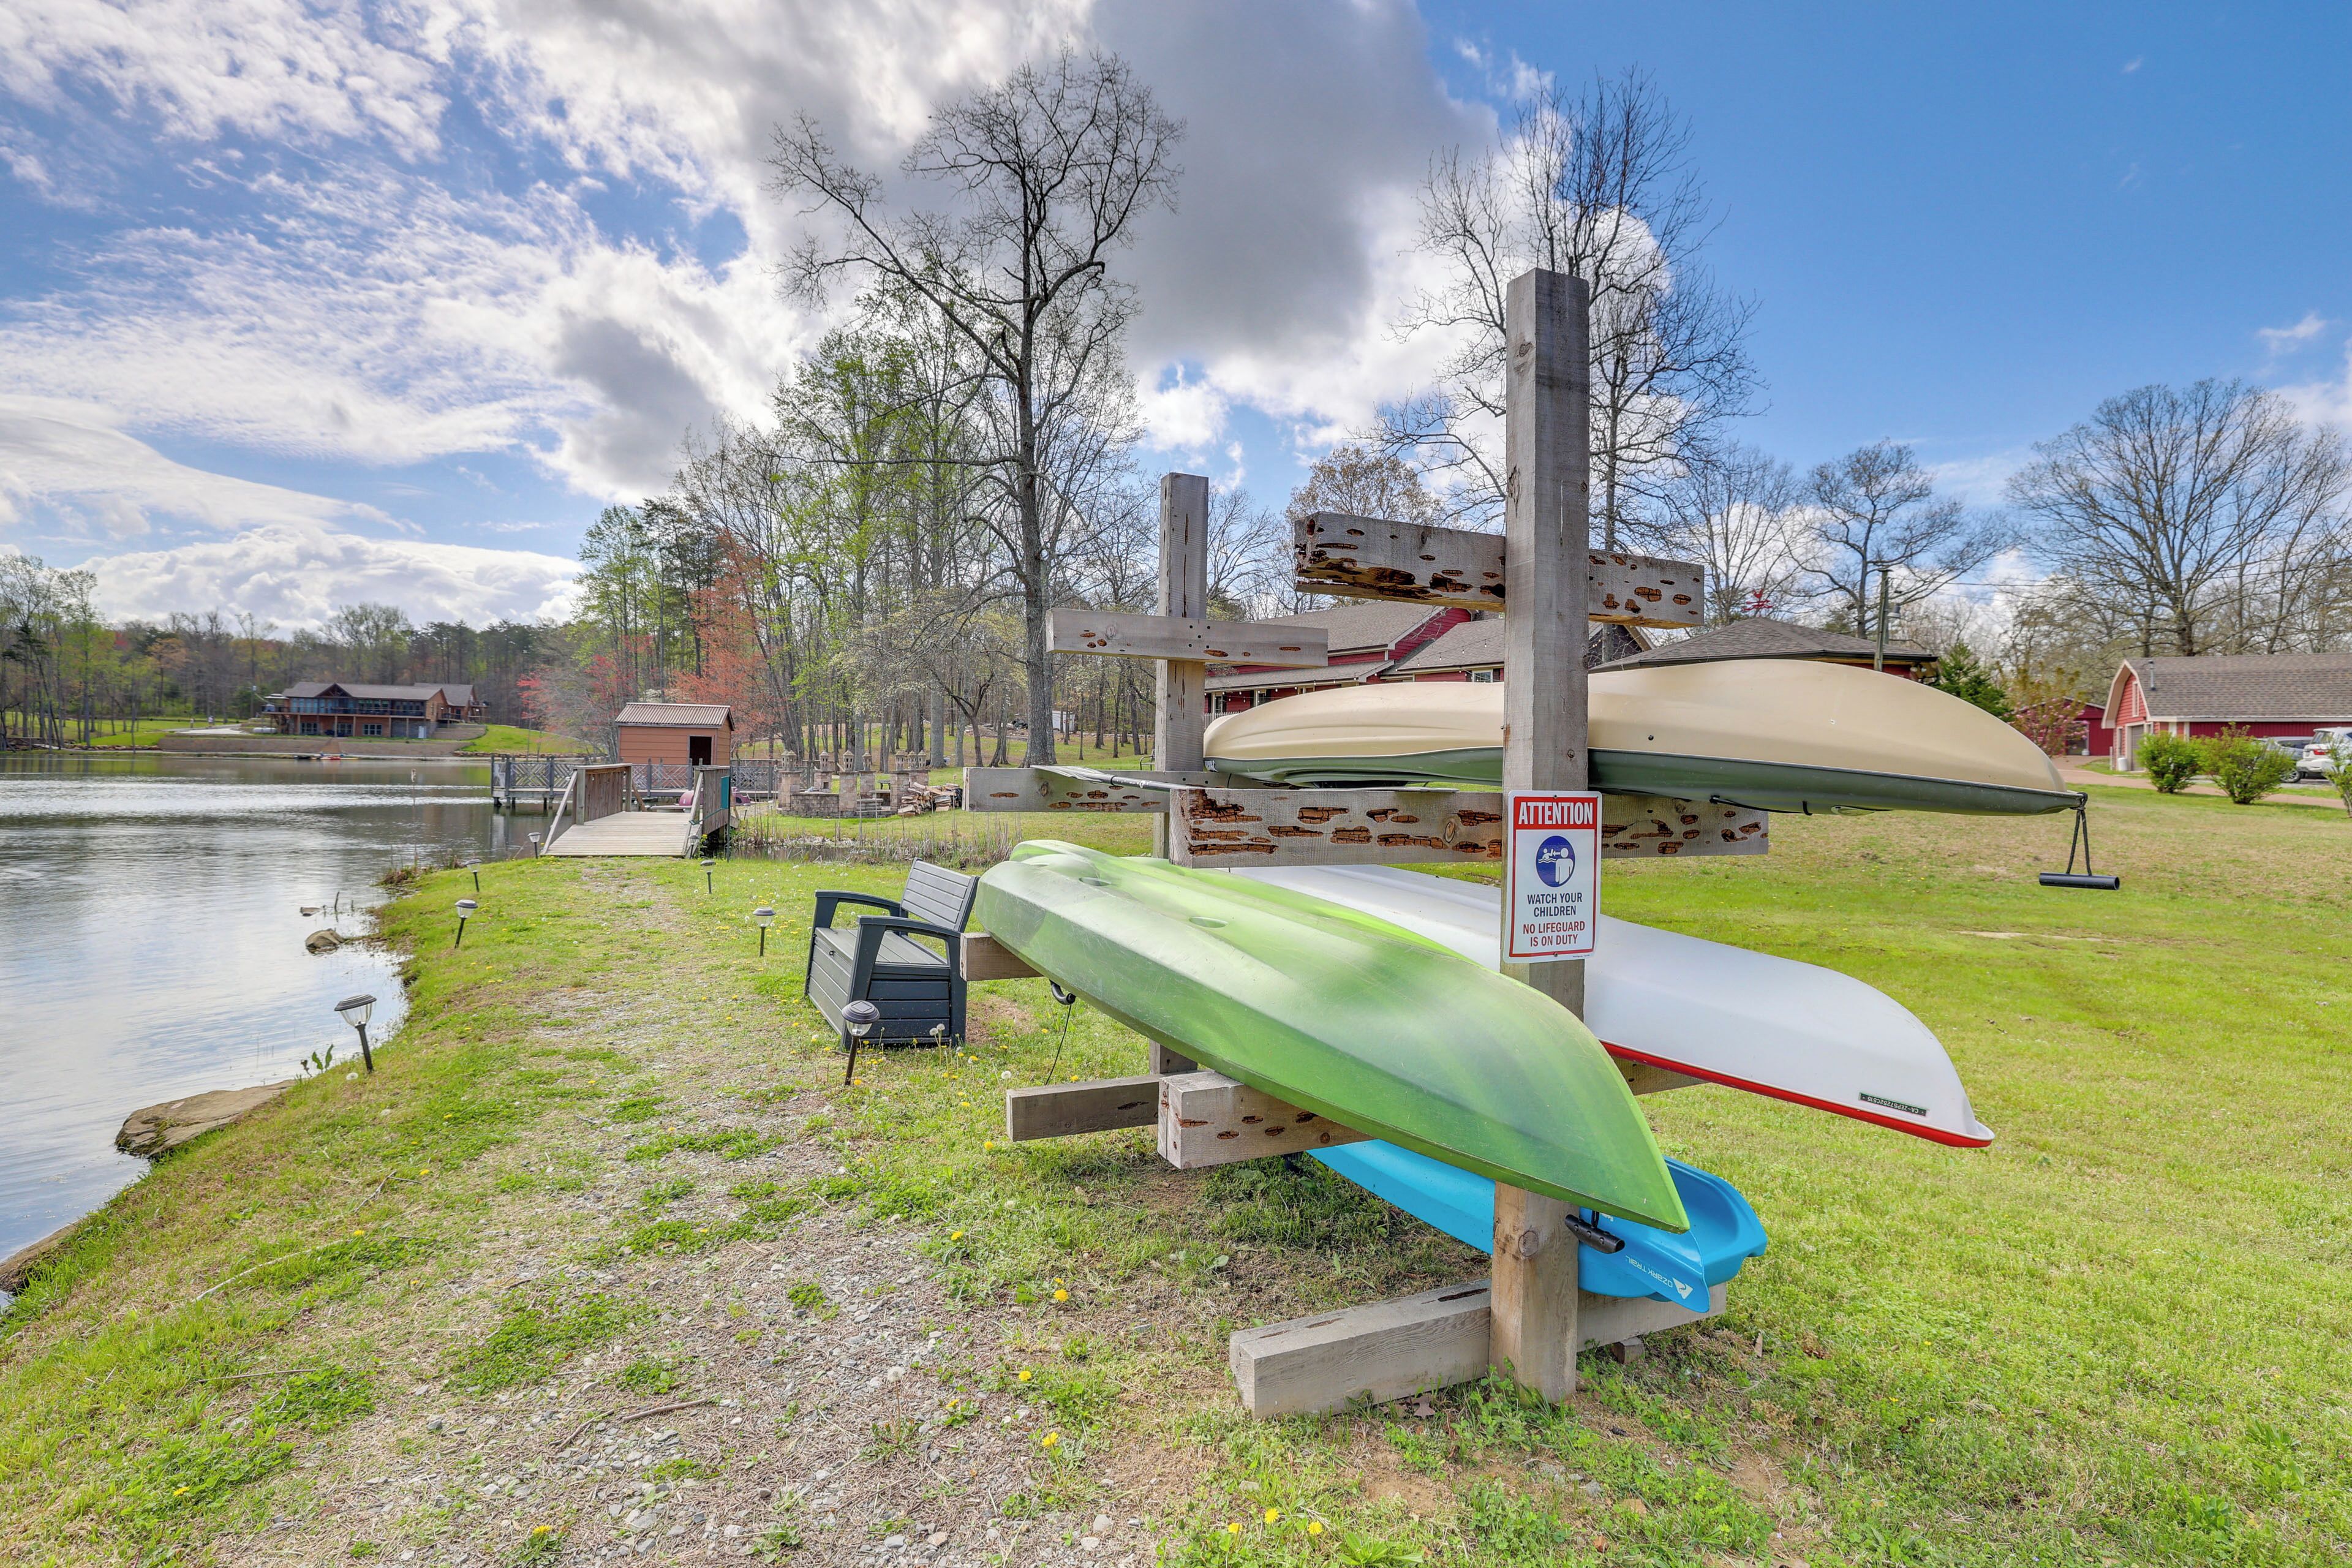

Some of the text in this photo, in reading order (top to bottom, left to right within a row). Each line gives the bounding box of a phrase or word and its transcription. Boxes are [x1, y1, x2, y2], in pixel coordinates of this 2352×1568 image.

[1518, 802, 1593, 825] ATTENTION
[1527, 892, 1583, 905] WATCH YOUR
[1533, 905, 1577, 918] CHILDREN
[1523, 921, 1585, 935] NO LIFEGUARD
[1530, 933, 1578, 947] IS ON DUTY
